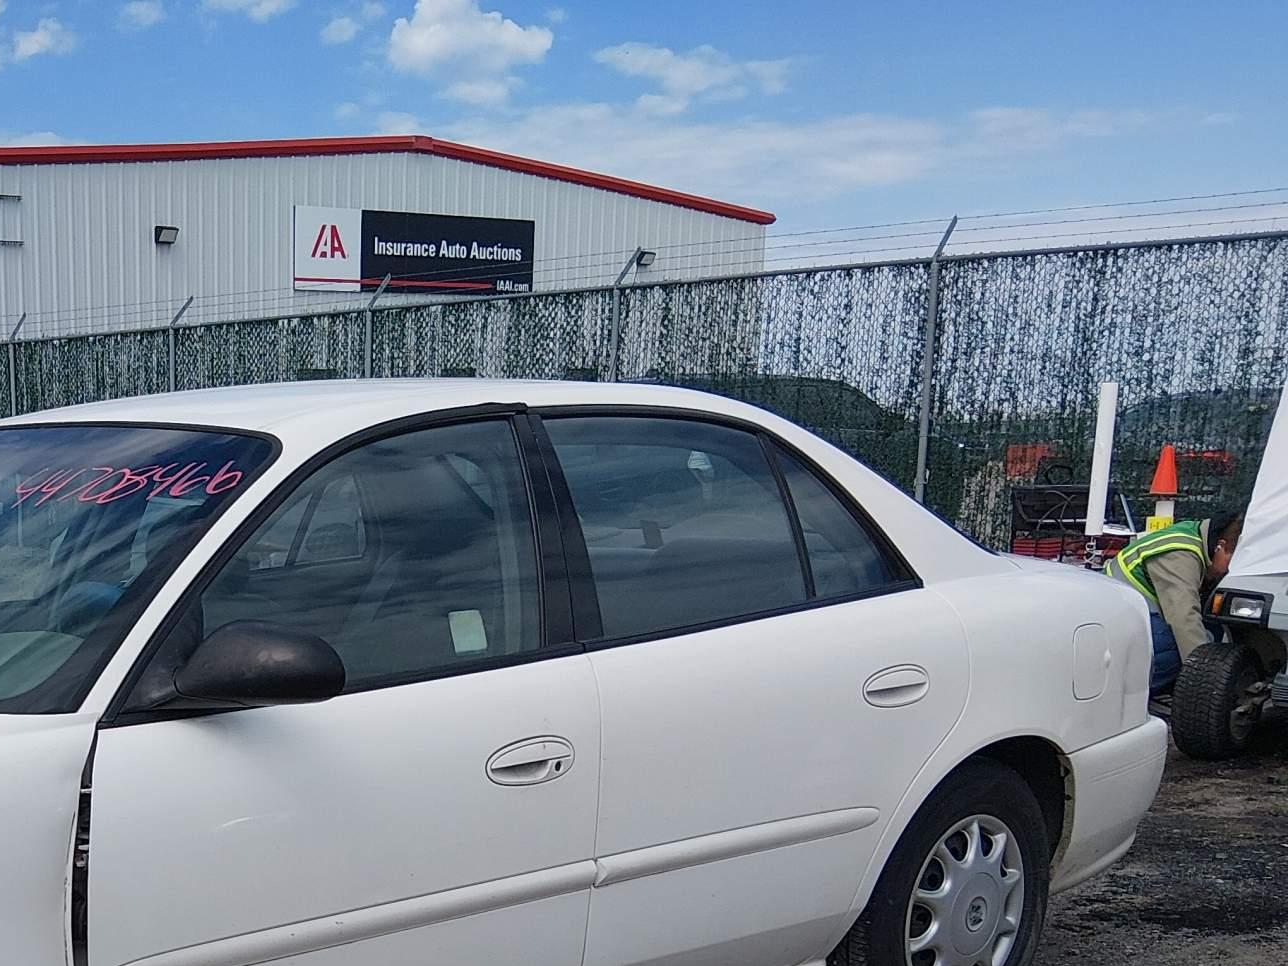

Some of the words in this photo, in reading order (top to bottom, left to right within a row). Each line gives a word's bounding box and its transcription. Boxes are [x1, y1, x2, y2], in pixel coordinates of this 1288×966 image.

[374, 236, 436, 257] Insurance
[439, 240, 467, 259] Auto
[469, 241, 522, 261] Auctions
[496, 279, 529, 292] IAAI.com
[11, 460, 243, 509] 44708466
